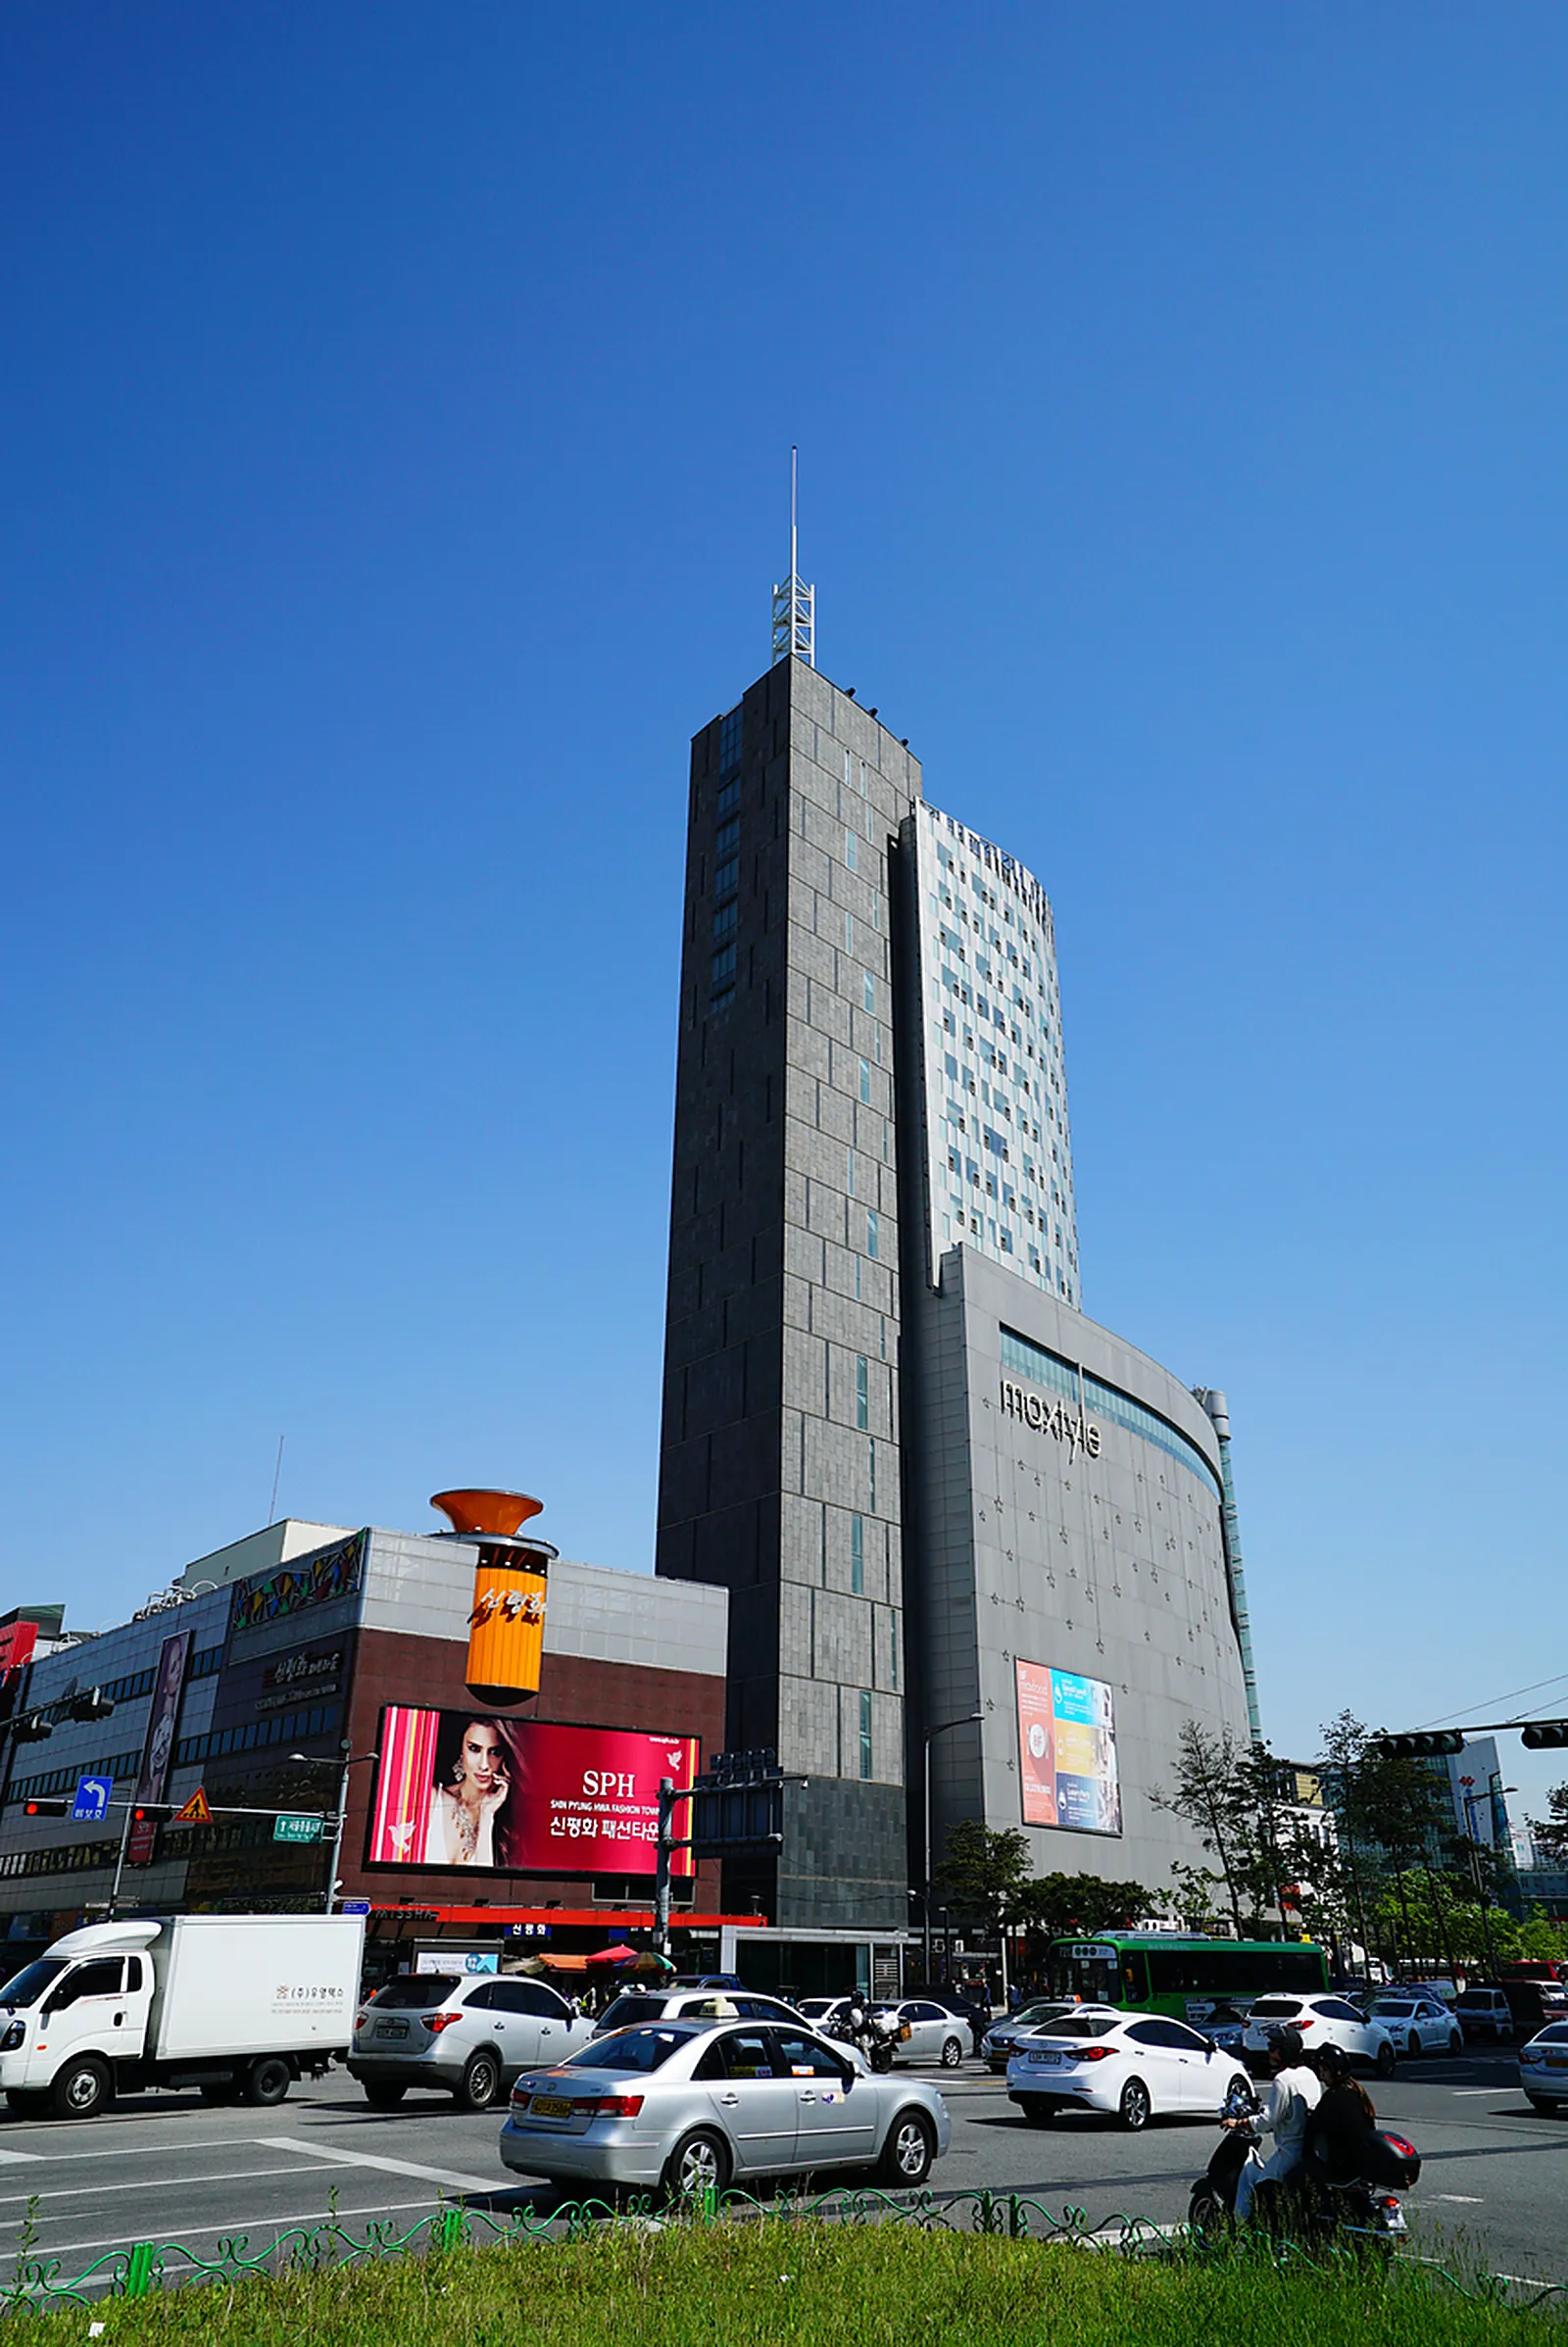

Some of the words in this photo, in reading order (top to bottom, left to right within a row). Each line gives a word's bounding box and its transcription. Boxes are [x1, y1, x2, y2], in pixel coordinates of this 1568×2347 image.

[480, 1588, 549, 1616] 신평화
[582, 1770, 635, 1798] SPH
[550, 1816, 599, 1838] 신평화
[601, 1819, 660, 1842] 패션타운
[375, 1906, 433, 1920] MISSHA
[512, 1923, 547, 1935] 신평화
